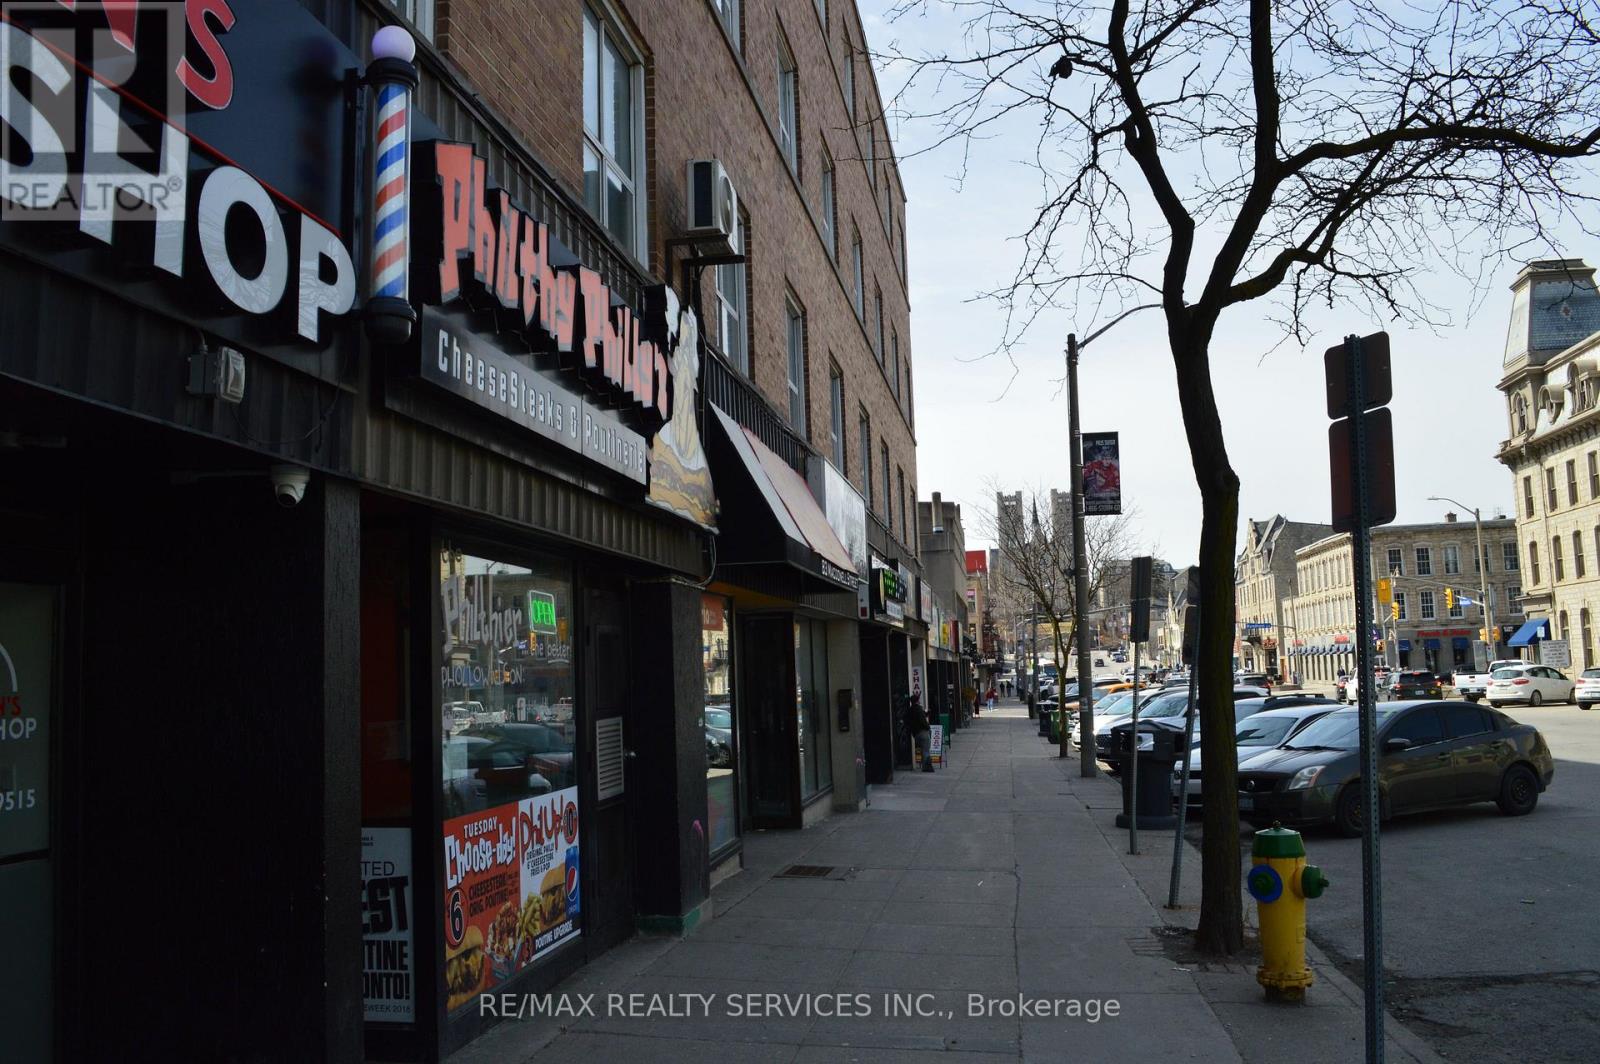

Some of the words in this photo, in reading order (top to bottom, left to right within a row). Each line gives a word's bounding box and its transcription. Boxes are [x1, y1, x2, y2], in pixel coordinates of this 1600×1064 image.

[0, 20, 357, 343] SHOP
[585, 412, 644, 473] Poutinerie
[532, 599, 556, 626] OPEN
[463, 815, 498, 839] TUESDAY
